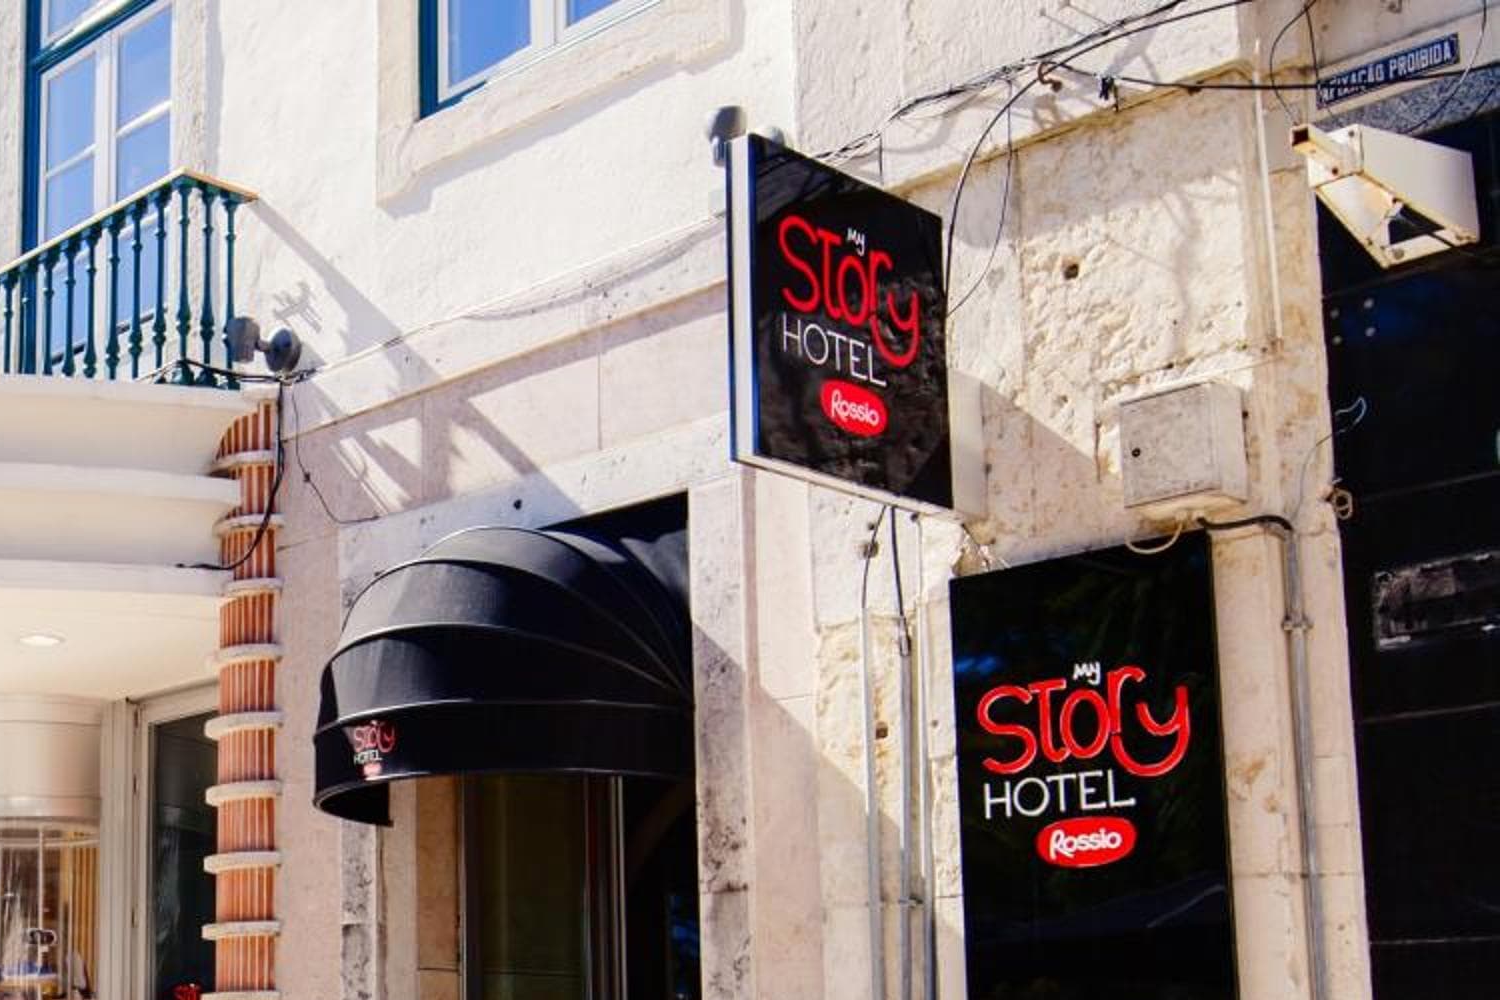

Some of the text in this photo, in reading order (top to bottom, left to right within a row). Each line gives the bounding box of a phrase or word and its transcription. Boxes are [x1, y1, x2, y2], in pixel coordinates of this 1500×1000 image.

[1388, 41, 1451, 80] PROIBIDA
[782, 311, 888, 388] HOTEL
[830, 389, 880, 426] Rossio
[983, 769, 1137, 820] HOTEL
[1049, 827, 1123, 861] Rossio
